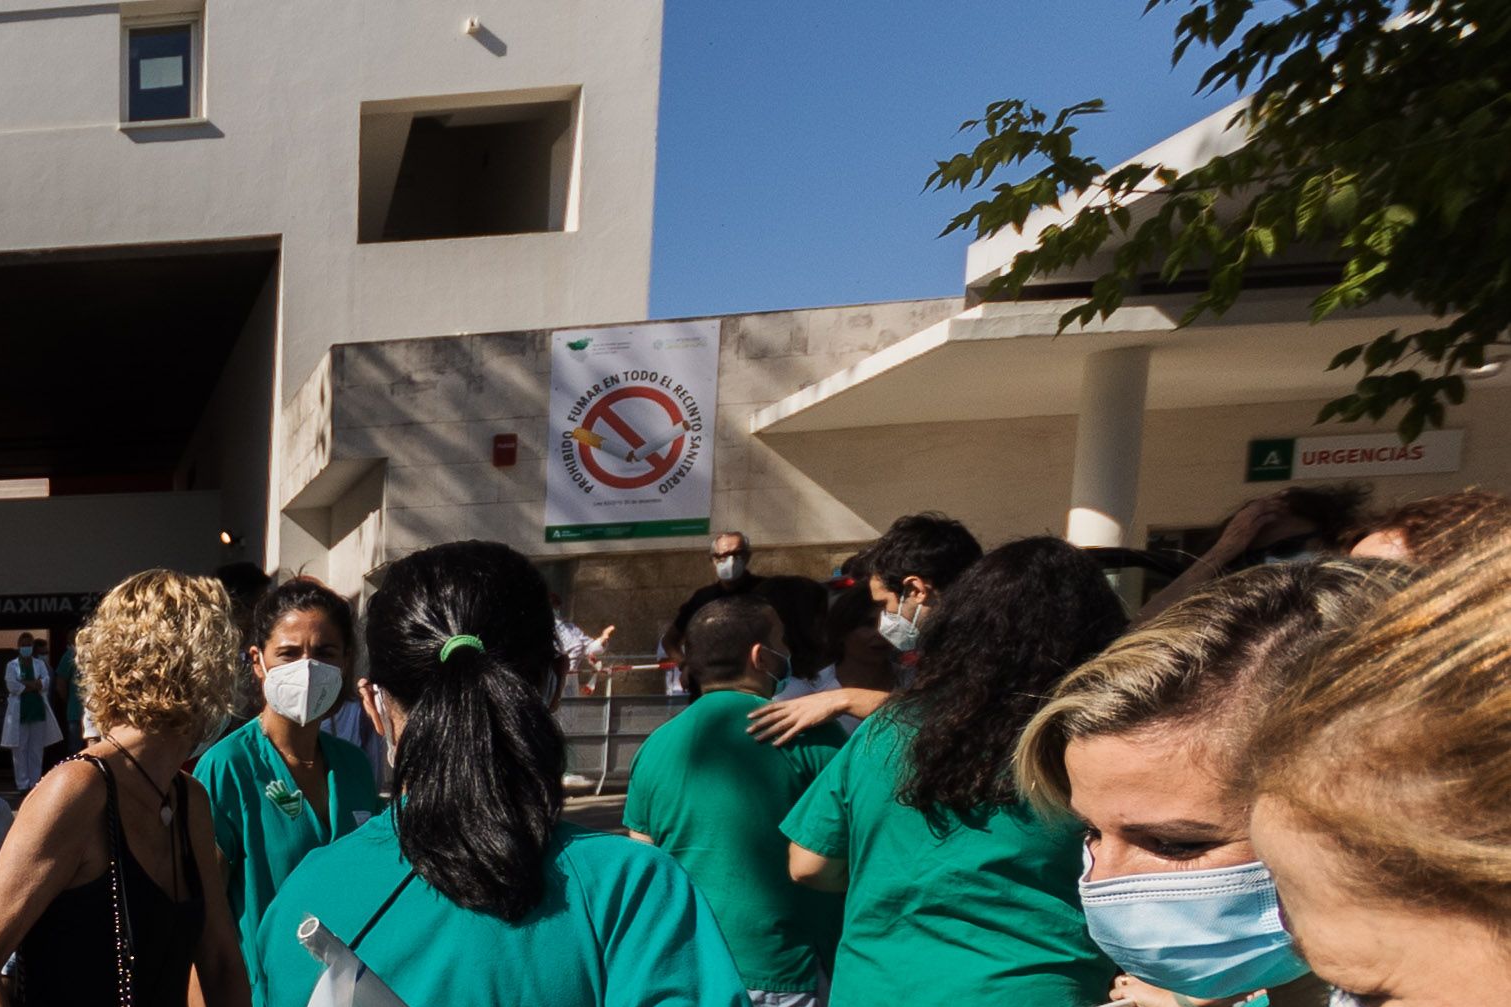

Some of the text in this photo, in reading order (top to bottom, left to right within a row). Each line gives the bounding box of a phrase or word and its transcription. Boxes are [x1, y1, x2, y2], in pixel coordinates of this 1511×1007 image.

[562, 370, 702, 494] PROHIBIDO FUMAR EN TODO EL RECINTO SANITARIO
[1301, 445, 1425, 467] URGENCIAS
